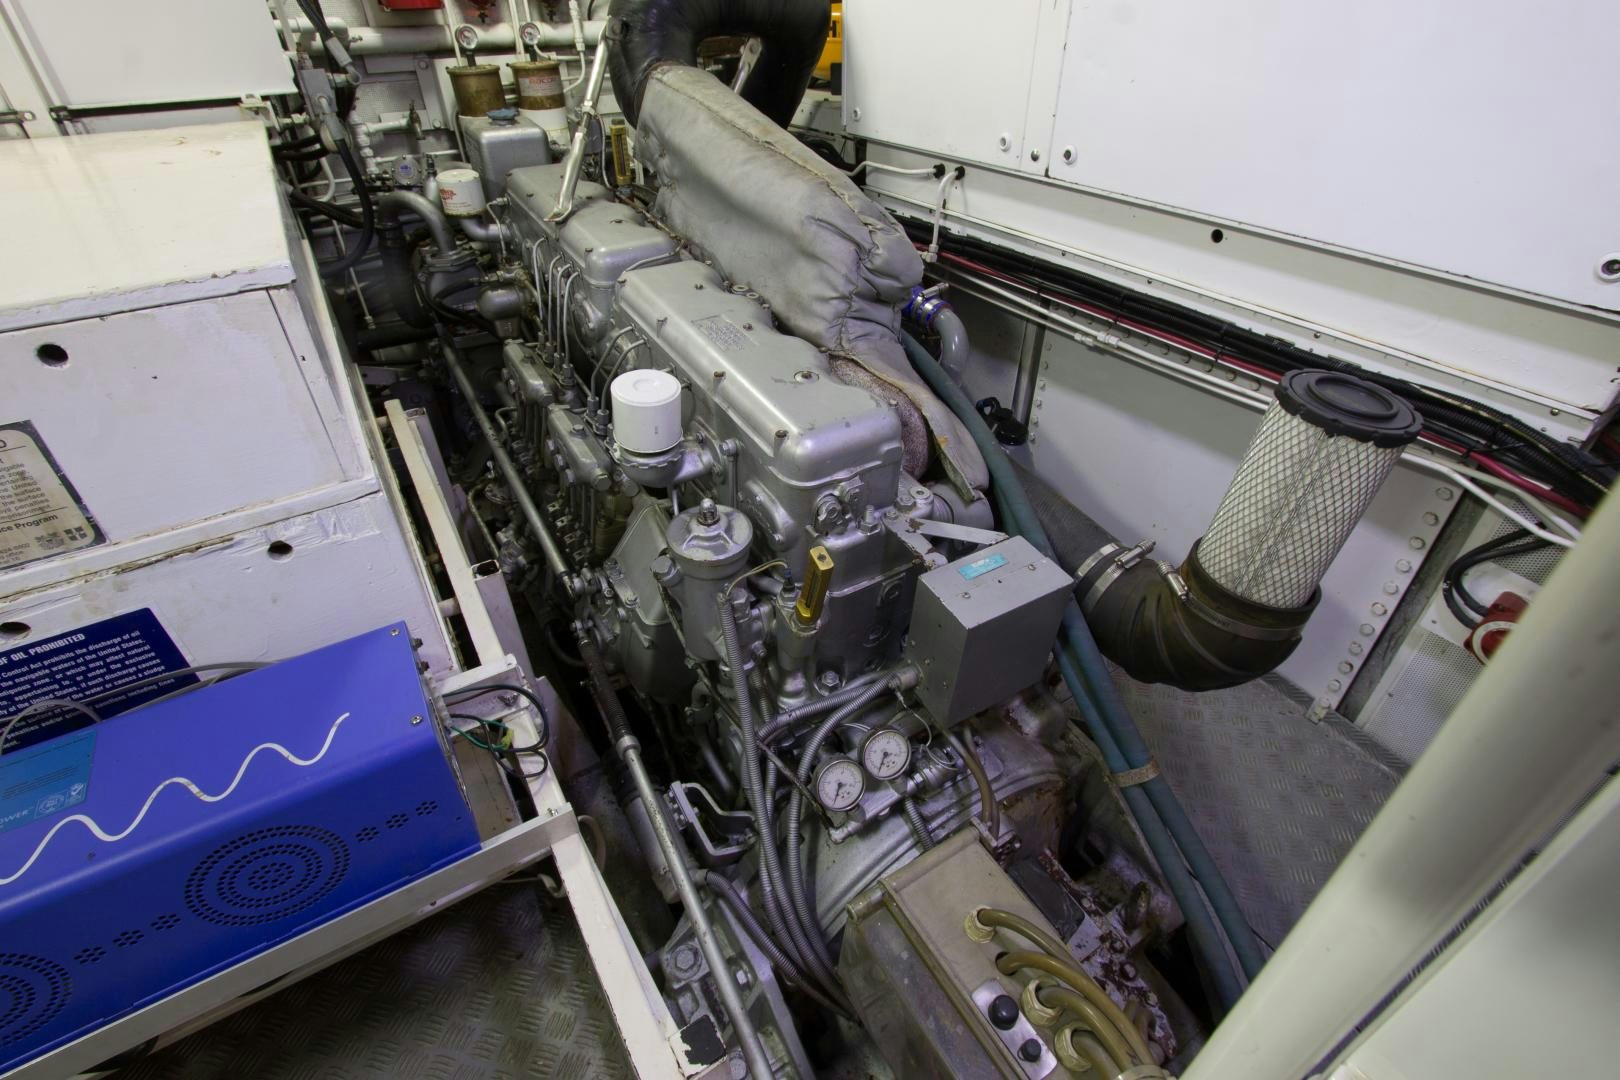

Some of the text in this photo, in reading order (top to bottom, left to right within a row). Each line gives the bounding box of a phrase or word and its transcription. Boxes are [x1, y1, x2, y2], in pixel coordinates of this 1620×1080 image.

[14, 513, 58, 530] Program
[1, 630, 141, 678] Control Act prohibits the discharge of oil
[10, 651, 28, 662] OIL
[28, 633, 86, 656] PROHIBITED
[65, 666, 87, 676] which
[88, 660, 104, 670] may
[105, 652, 125, 663] affect
[126, 643, 151, 656] natural
[0, 680, 14, 688] the
[14, 668, 51, 683] navigable
[50, 660, 76, 671] waters
[84, 653, 97, 661] the
[97, 645, 121, 657] United
[14, 683, 60, 701] appertaining
[87, 667, 107, 677] under
[124, 651, 156, 665] exclusive
[30, 693, 55, 705] United
[87, 677, 104, 686] such
[104, 666, 137, 680] discharge
[137, 657, 161, 669] causes
[84, 685, 104, 695] water
[113, 674, 137, 686] causes
[143, 665, 166, 676] sludge
[6, 725, 40, 739] penalties
